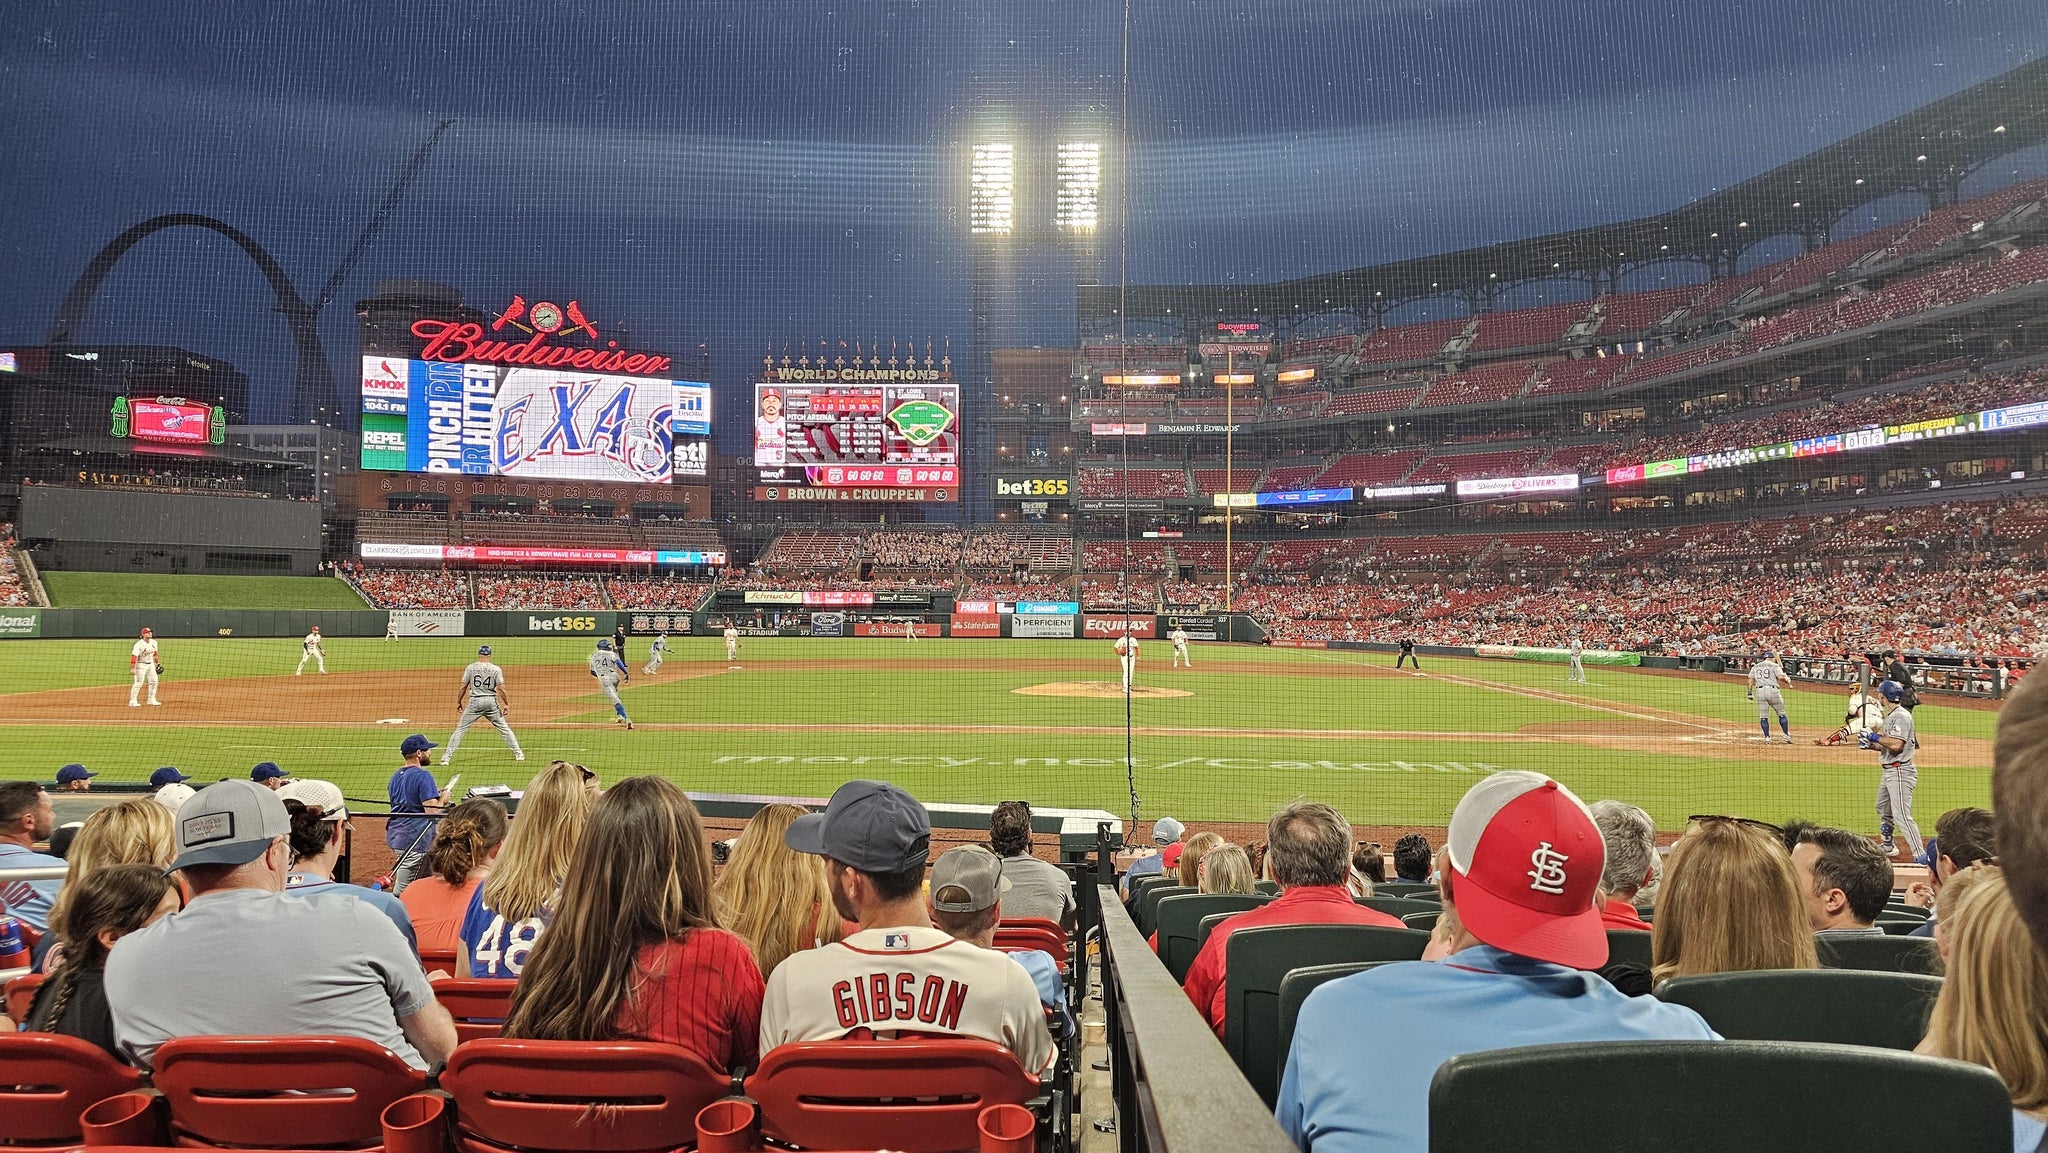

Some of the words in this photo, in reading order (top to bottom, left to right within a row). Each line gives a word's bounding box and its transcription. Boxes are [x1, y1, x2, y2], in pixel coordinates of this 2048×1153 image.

[411, 320, 671, 374] Budweiser
[1228, 344, 1269, 352] BUDWEISER
[186, 357, 210, 371] Deloitte
[777, 367, 837, 381] WORLD
[841, 368, 940, 381] CHAMPIONS
[364, 379, 406, 390] KMOX
[156, 395, 187, 406] Coca-Cola
[364, 401, 389, 411] 104.1
[391, 404, 406, 412] FM
[463, 363, 496, 445] HITTER
[787, 413, 806, 421] PITCH
[807, 413, 836, 421] ARSENAL
[1158, 424, 1194, 432] BENJAMIN
[1203, 424, 1239, 432] EDWARDS
[1900, 422, 1920, 433] CODY
[1920, 417, 1956, 431] FREEMAN
[364, 431, 405, 445] REPEL
[428, 399, 463, 473] PINCH
[673, 442, 707, 462] stl
[760, 470, 780, 479] Mercy
[847, 470, 858, 481] GO
[859, 470, 871, 481] GO
[872, 470, 884, 481] GO
[916, 470, 928, 481] GO
[929, 470, 940, 481] GO
[941, 470, 953, 481] GO
[406, 479, 412, 491] 1
[419, 480, 430, 492] 2
[436, 480, 446, 493] 6
[454, 481, 464, 494] 9
[472, 482, 485, 495] 10
[494, 483, 508, 496] 14
[516, 484, 530, 497] 17
[537, 485, 554, 498] 20
[564, 486, 581, 499] 23
[587, 487, 604, 500] 24
[611, 488, 628, 500] 42
[635, 489, 652, 502] 45
[656, 489, 673, 503] 85
[997, 478, 1069, 495] bet365
[787, 488, 837, 500] BROWN
[840, 491, 849, 500] &
[852, 489, 925, 500] CROUPPEN
[365, 546, 399, 554] CLARKSON
[409, 547, 439, 555] JEWELERS
[446, 546, 476, 557] Coca-Cola
[625, 551, 652, 561] Coca-Cola
[749, 591, 799, 600] Schnucks
[960, 602, 989, 612] FABICK
[528, 615, 596, 631] bet365
[818, 615, 837, 624] Ford
[1023, 620, 1073, 628] PERFICIENT
[1085, 619, 1150, 634] EQUIFAX
[595, 657, 608, 668] 24
[1756, 668, 1771, 680] 39
[473, 674, 492, 689] 64
[475, 916, 548, 979] 48
[832, 972, 968, 1031] GIBSON
